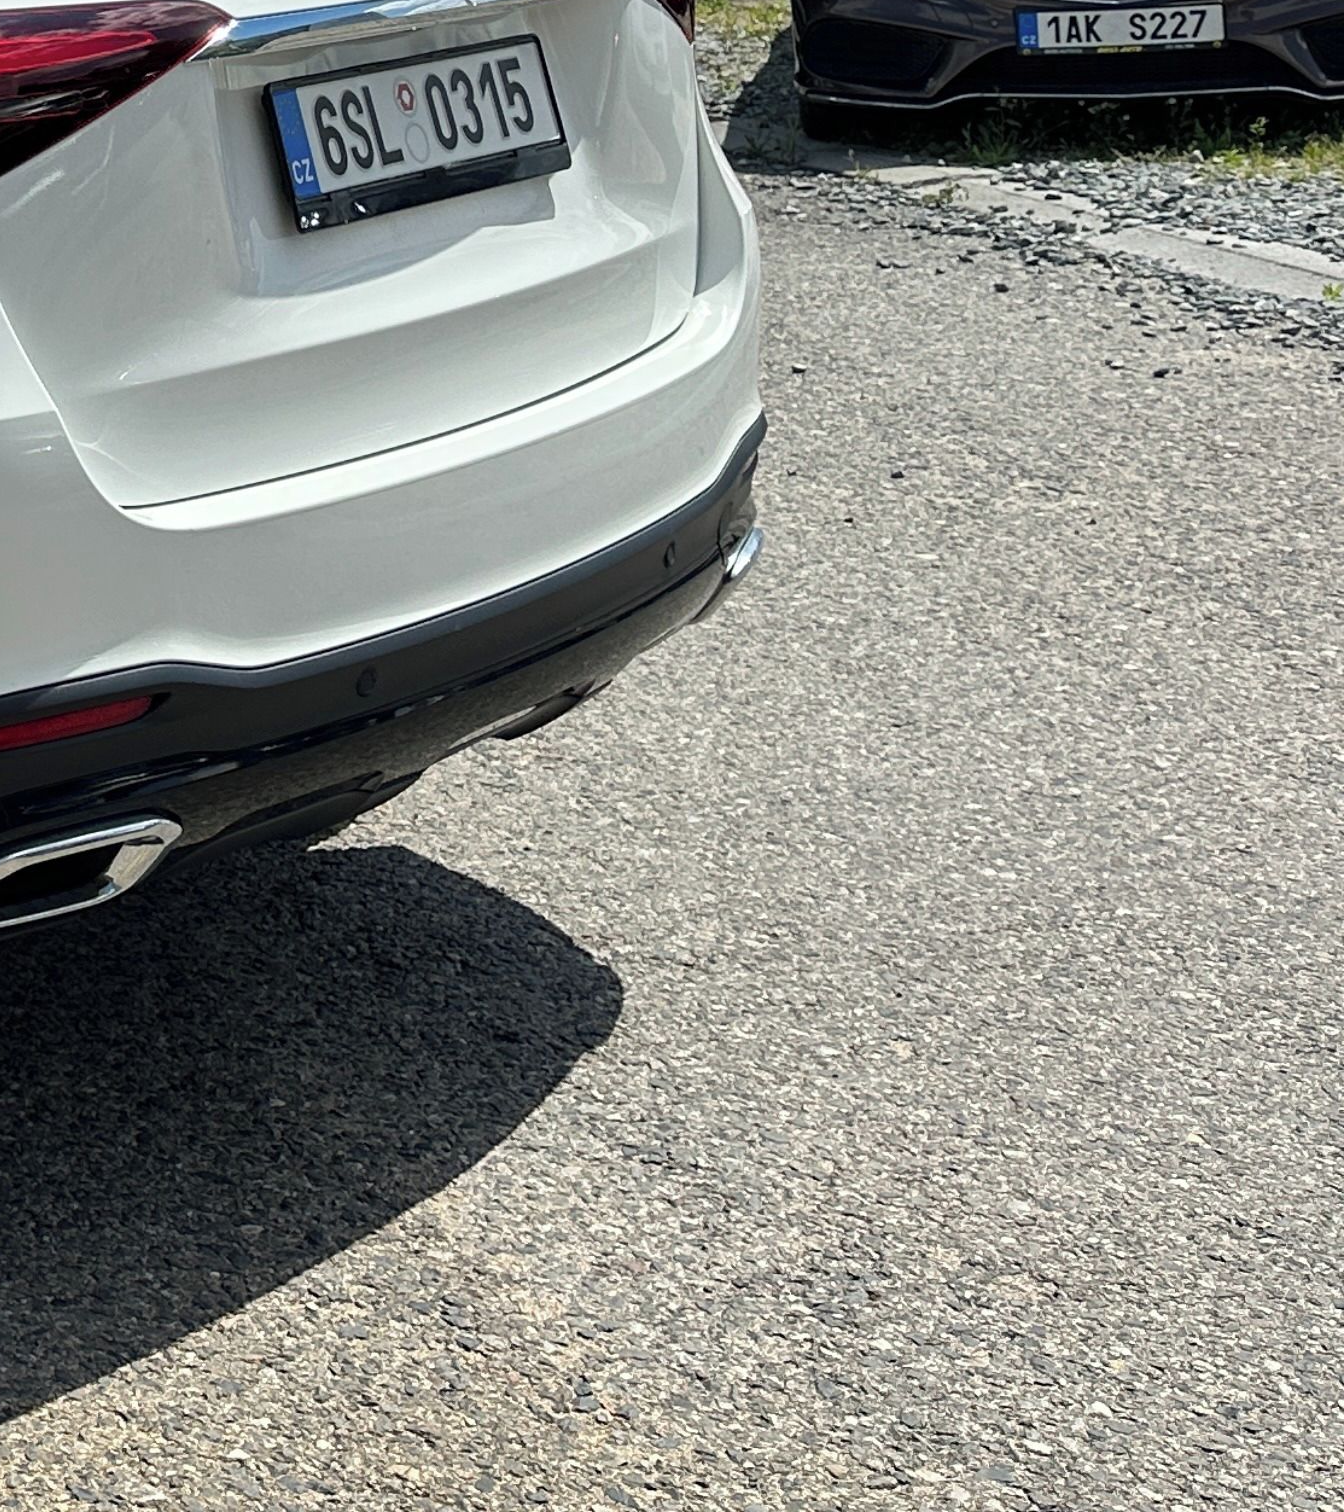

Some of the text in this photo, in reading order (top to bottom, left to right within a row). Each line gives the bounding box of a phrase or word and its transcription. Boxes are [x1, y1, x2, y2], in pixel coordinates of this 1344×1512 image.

[1021, 35, 1037, 45] CZ
[1048, 10, 1207, 44] 1AK S227
[314, 56, 534, 176] 6SL 0315
[291, 158, 314, 185] CZ
